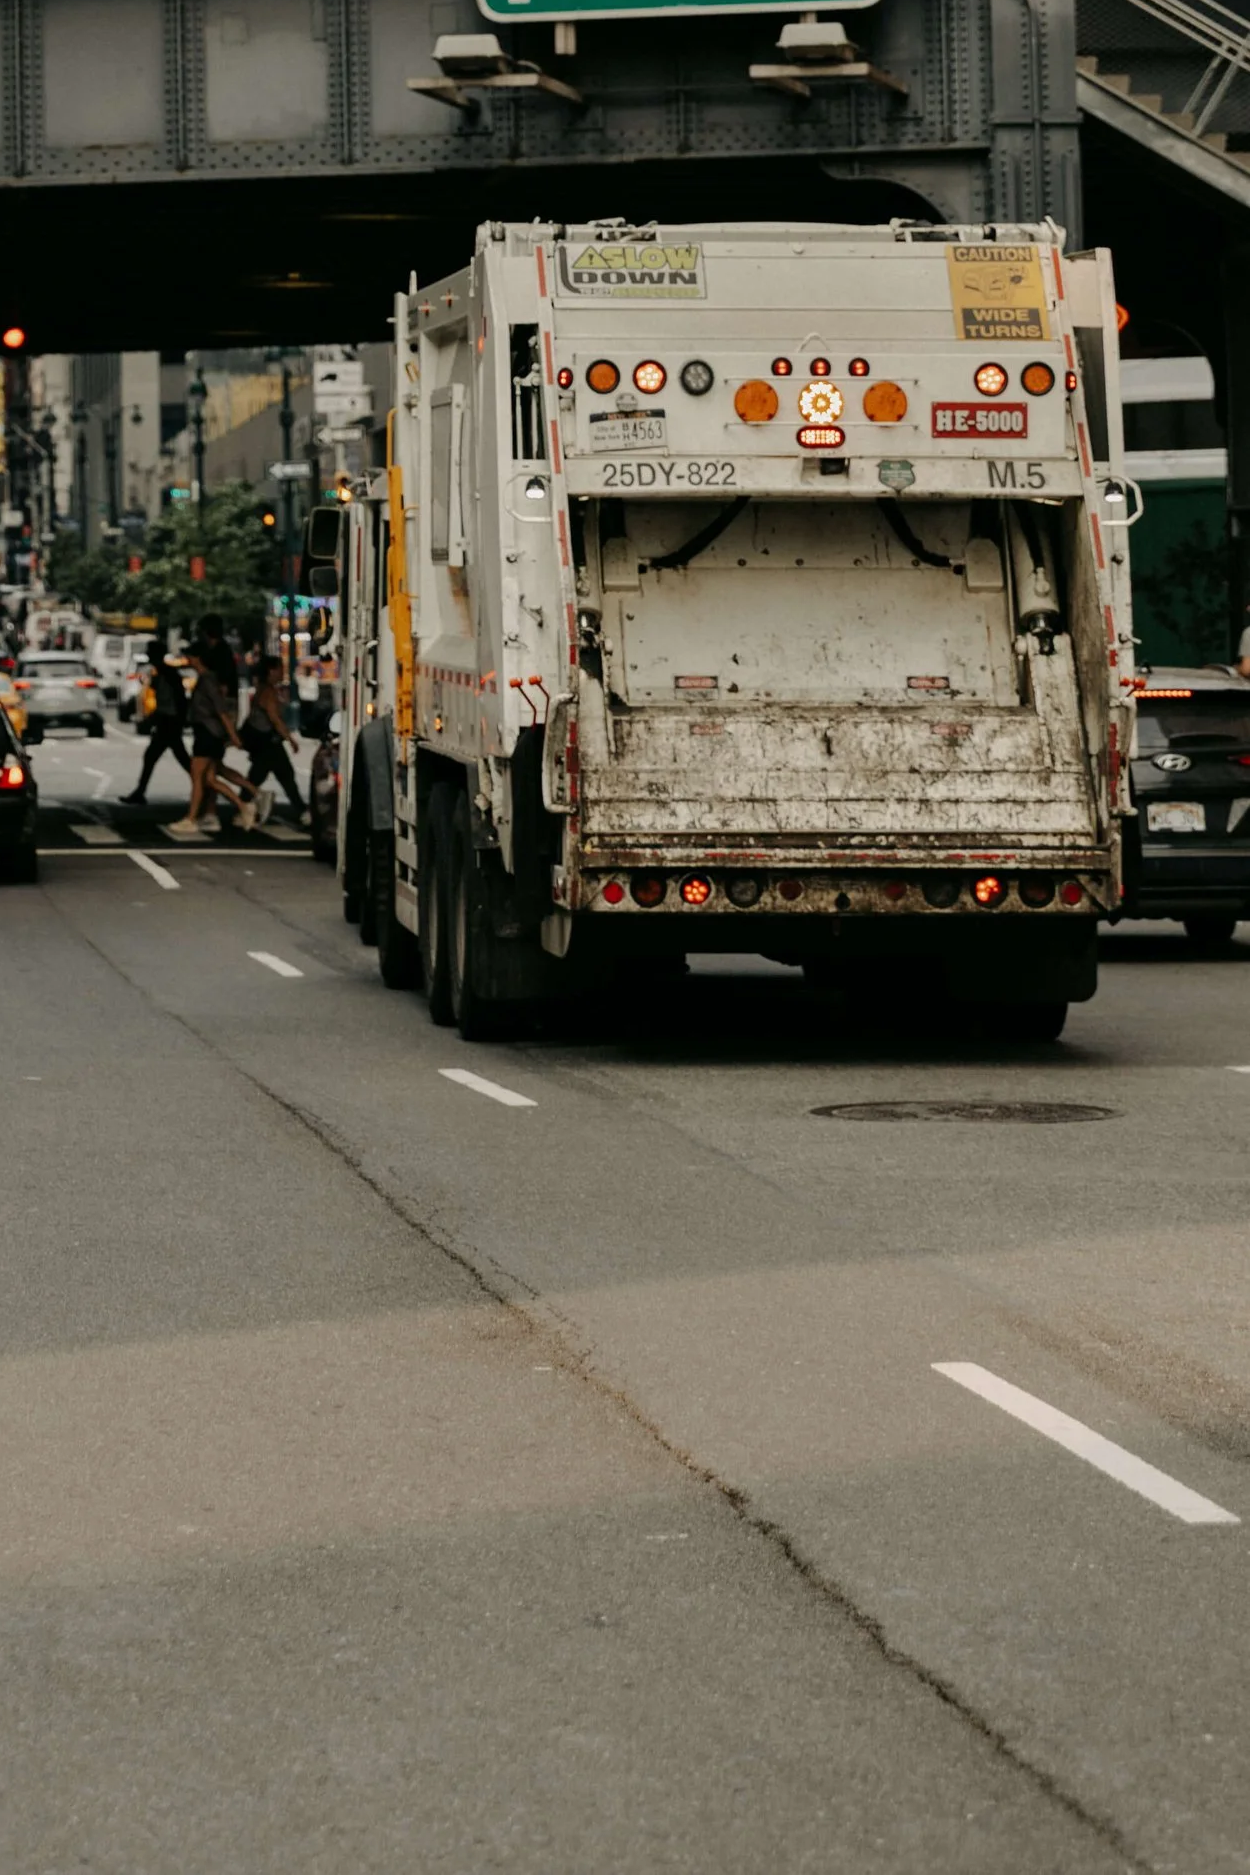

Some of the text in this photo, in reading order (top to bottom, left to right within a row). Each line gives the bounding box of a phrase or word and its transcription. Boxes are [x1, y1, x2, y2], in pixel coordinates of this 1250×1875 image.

[600, 246, 699, 270] SLOW
[955, 247, 1031, 261] CAUTION
[573, 272, 698, 285] DOWN
[972, 309, 1030, 321] WIDE
[966, 325, 1041, 337] TURNS
[935, 409, 1024, 432] HE-5000
[602, 462, 738, 488] 25DY-822
[988, 460, 1046, 489] M.5
